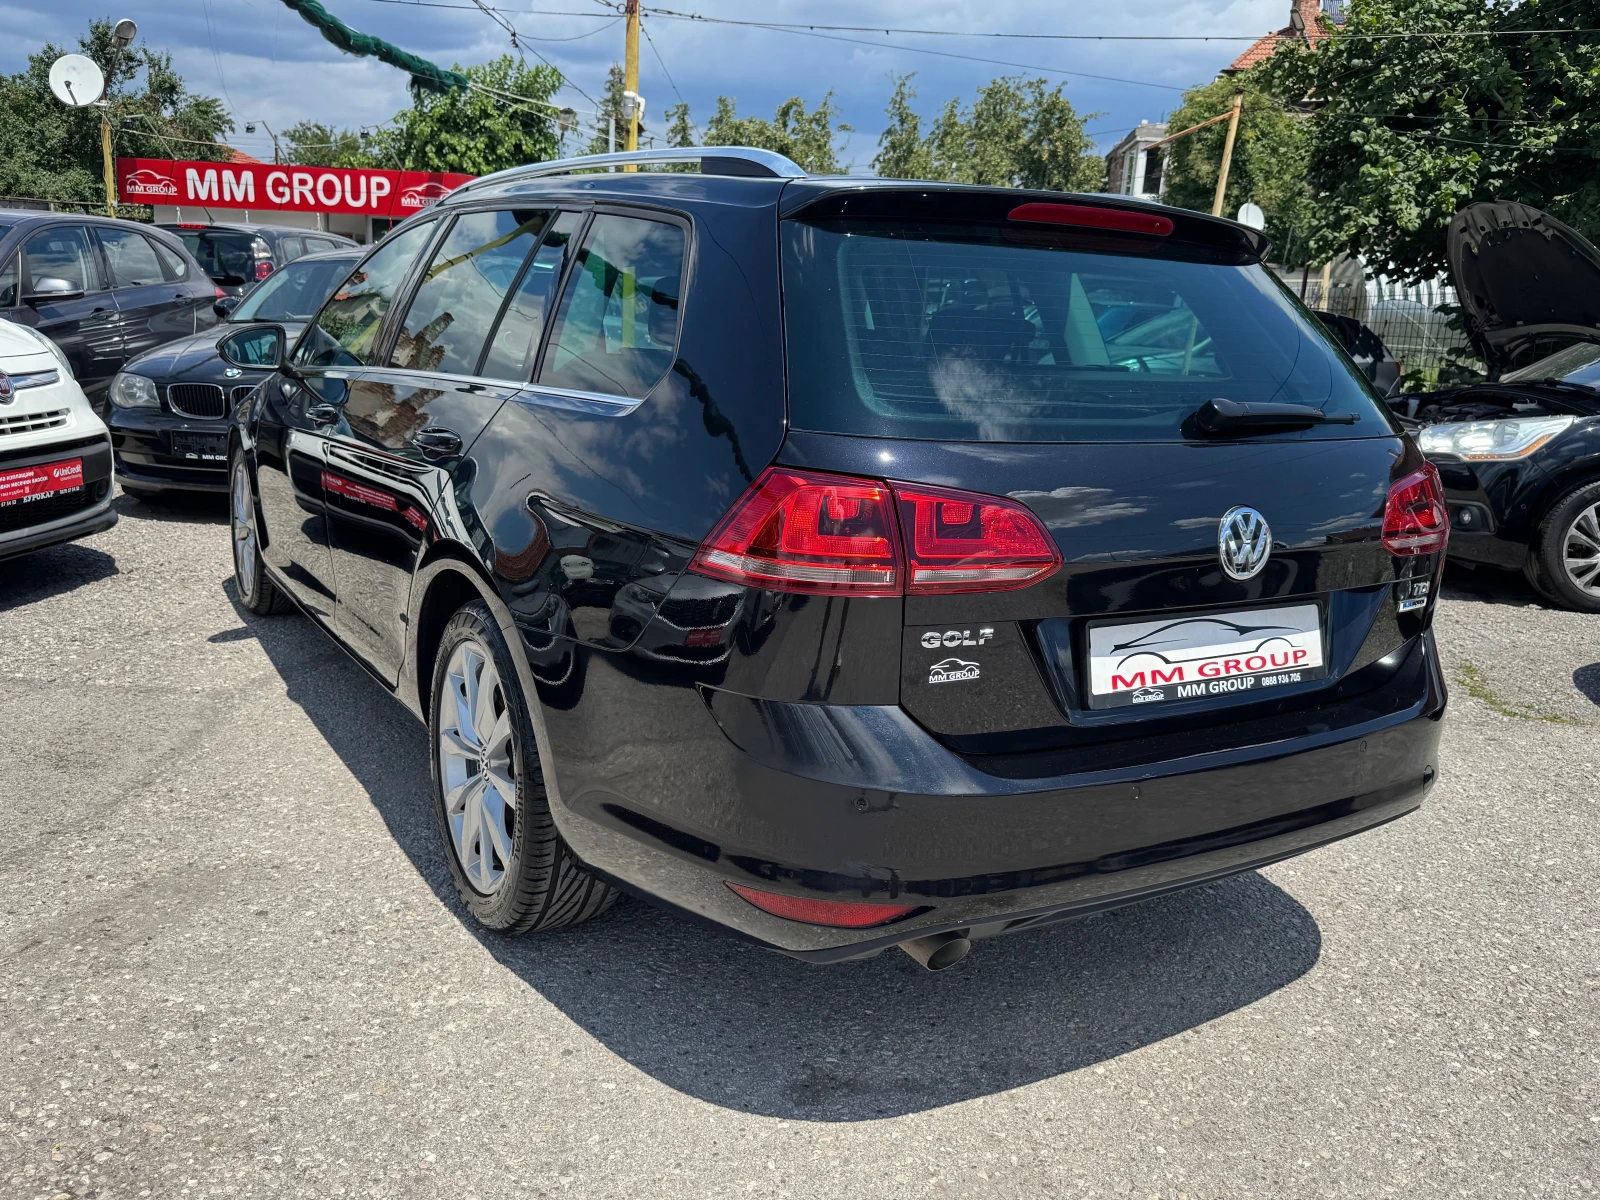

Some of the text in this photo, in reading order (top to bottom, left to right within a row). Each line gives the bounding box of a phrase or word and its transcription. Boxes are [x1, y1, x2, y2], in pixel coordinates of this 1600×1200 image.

[146, 186, 178, 194] GROUP
[185, 168, 391, 209] MM GROUP
[401, 197, 420, 205] MM
[921, 628, 994, 649] GOLF
[929, 670, 980, 682] MM GROUP
[1111, 649, 1308, 690] MM GROUP
[1177, 672, 1302, 698] MM GROUP 0888 936 705
[514, 773, 525, 861] UNIROYAL
